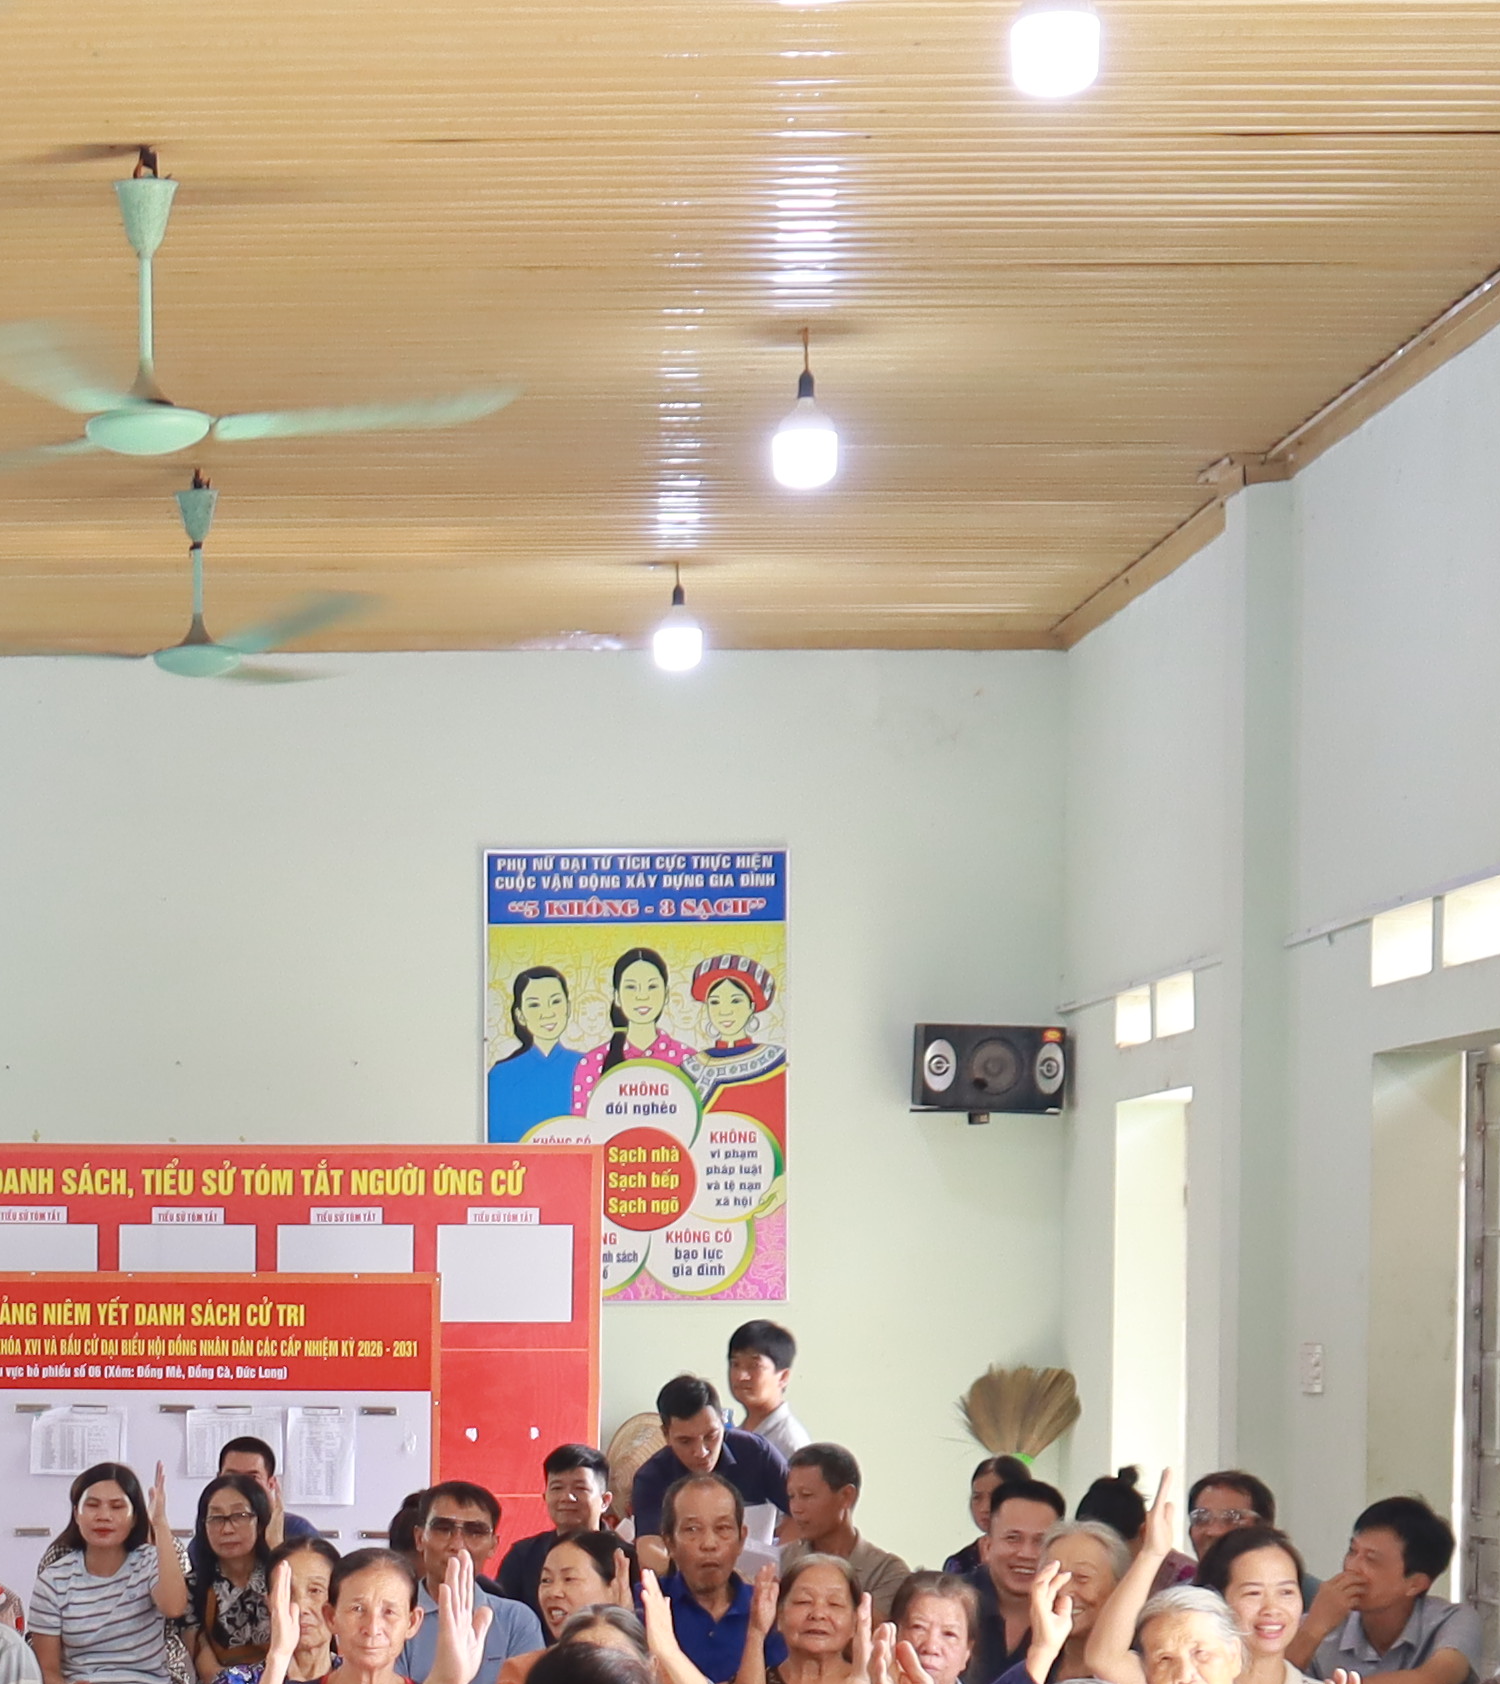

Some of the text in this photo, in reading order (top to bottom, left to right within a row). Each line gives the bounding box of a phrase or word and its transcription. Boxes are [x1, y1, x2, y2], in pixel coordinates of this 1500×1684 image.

[497, 857, 526, 873] PHỤ
[532, 855, 555, 871] NỮ
[560, 857, 587, 873] ĐẠI
[617, 855, 651, 870] TÍCH
[655, 854, 686, 872] CỰC
[691, 854, 732, 872] THỰC
[736, 853, 773, 871] HIỆN
[495, 871, 776, 893] CUỘC VẬN ĐỘNG XÂY DỰNG GIA ĐÌNH
[544, 895, 640, 918] KHÔNG
[644, 905, 655, 914] -
[660, 898, 676, 916] 3
[619, 1081, 669, 1096] KHÔNG
[605, 1101, 678, 1116] đói nghèo
[710, 1128, 757, 1144] KHÔNG
[608, 1145, 680, 1166] Sạch nhà
[710, 1149, 758, 1161] vi phạm
[62, 1163, 133, 1199] SÁCH,
[142, 1158, 193, 1195] TIỂU
[202, 1159, 236, 1195] SỬ
[241, 1164, 293, 1196] TÓM
[301, 1160, 344, 1196] TẮT
[351, 1163, 425, 1196] NGƯỜI
[433, 1163, 483, 1196] ỨNG
[491, 1161, 526, 1196] CỬ
[706, 1164, 762, 1176] pháp luật
[608, 1168, 680, 1192] Sạch bếp
[706, 1180, 762, 1192] và tệ nạn
[608, 1196, 680, 1217] Sạch ngõ
[715, 1196, 752, 1208] xã hội
[665, 1227, 733, 1244] KHÔNG CÓ
[616, 1250, 639, 1263] sách
[674, 1247, 723, 1263] bạo lực
[672, 1263, 726, 1278] gia đình
[43, 1298, 91, 1326] NIÊM
[97, 1296, 129, 1326] YẾT
[134, 1303, 185, 1326] DANH
[191, 1298, 241, 1326] SÁCH
[246, 1296, 272, 1327] CỬ
[277, 1304, 305, 1327] TRI
[24, 1339, 41, 1356] XVI
[43, 1336, 58, 1356] VÀ
[60, 1333, 82, 1356] BẦU
[84, 1334, 100, 1356] CỬ
[101, 1338, 119, 1360] ĐẠI
[121, 1332, 146, 1356] BIỂU
[147, 1336, 166, 1360] HỘI
[168, 1334, 197, 1357] ĐỒNG
[200, 1336, 230, 1357] NHÂN
[231, 1336, 254, 1357] DÂN
[256, 1336, 278, 1357] CÁC
[280, 1334, 302, 1357] CẤP
[304, 1336, 339, 1361] NHIỆM
[341, 1337, 356, 1357] KỲ
[357, 1341, 384, 1358] 2026
[392, 1341, 418, 1358] 2031
[5, 1366, 25, 1379] vực
[41, 1362, 71, 1379] phiếu
[73, 1363, 87, 1378] số
[87, 1365, 102, 1378] 06
[104, 1365, 135, 1379] (Xóm:
[235, 1365, 257, 1379] Đức
[258, 1366, 288, 1380] Long)
